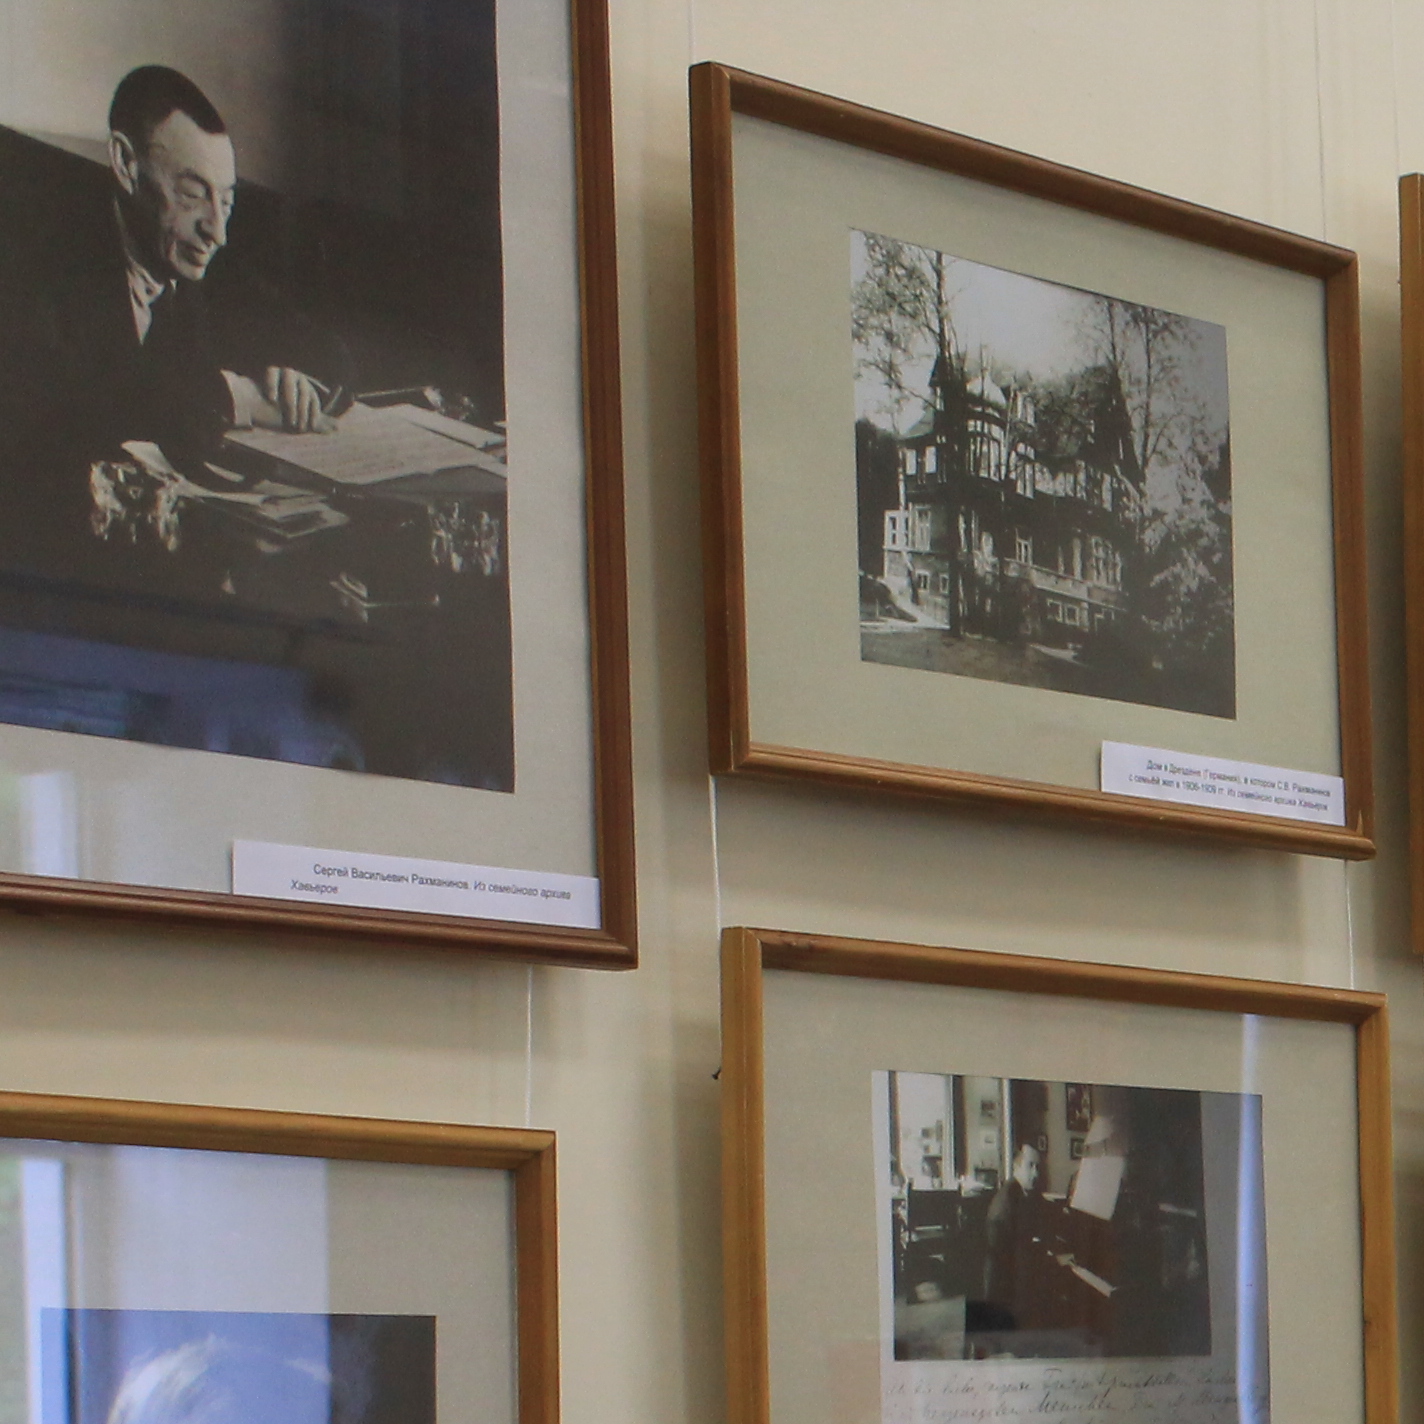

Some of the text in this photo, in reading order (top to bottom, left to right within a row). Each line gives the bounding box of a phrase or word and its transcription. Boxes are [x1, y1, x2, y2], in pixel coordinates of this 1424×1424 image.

[290, 880, 339, 895] Хавьеров
[313, 863, 349, 878] Сергей
[351, 867, 409, 883] Васильевич
[473, 880, 486, 891] Из
[488, 884, 538, 897] семейного
[540, 888, 571, 900] архива
